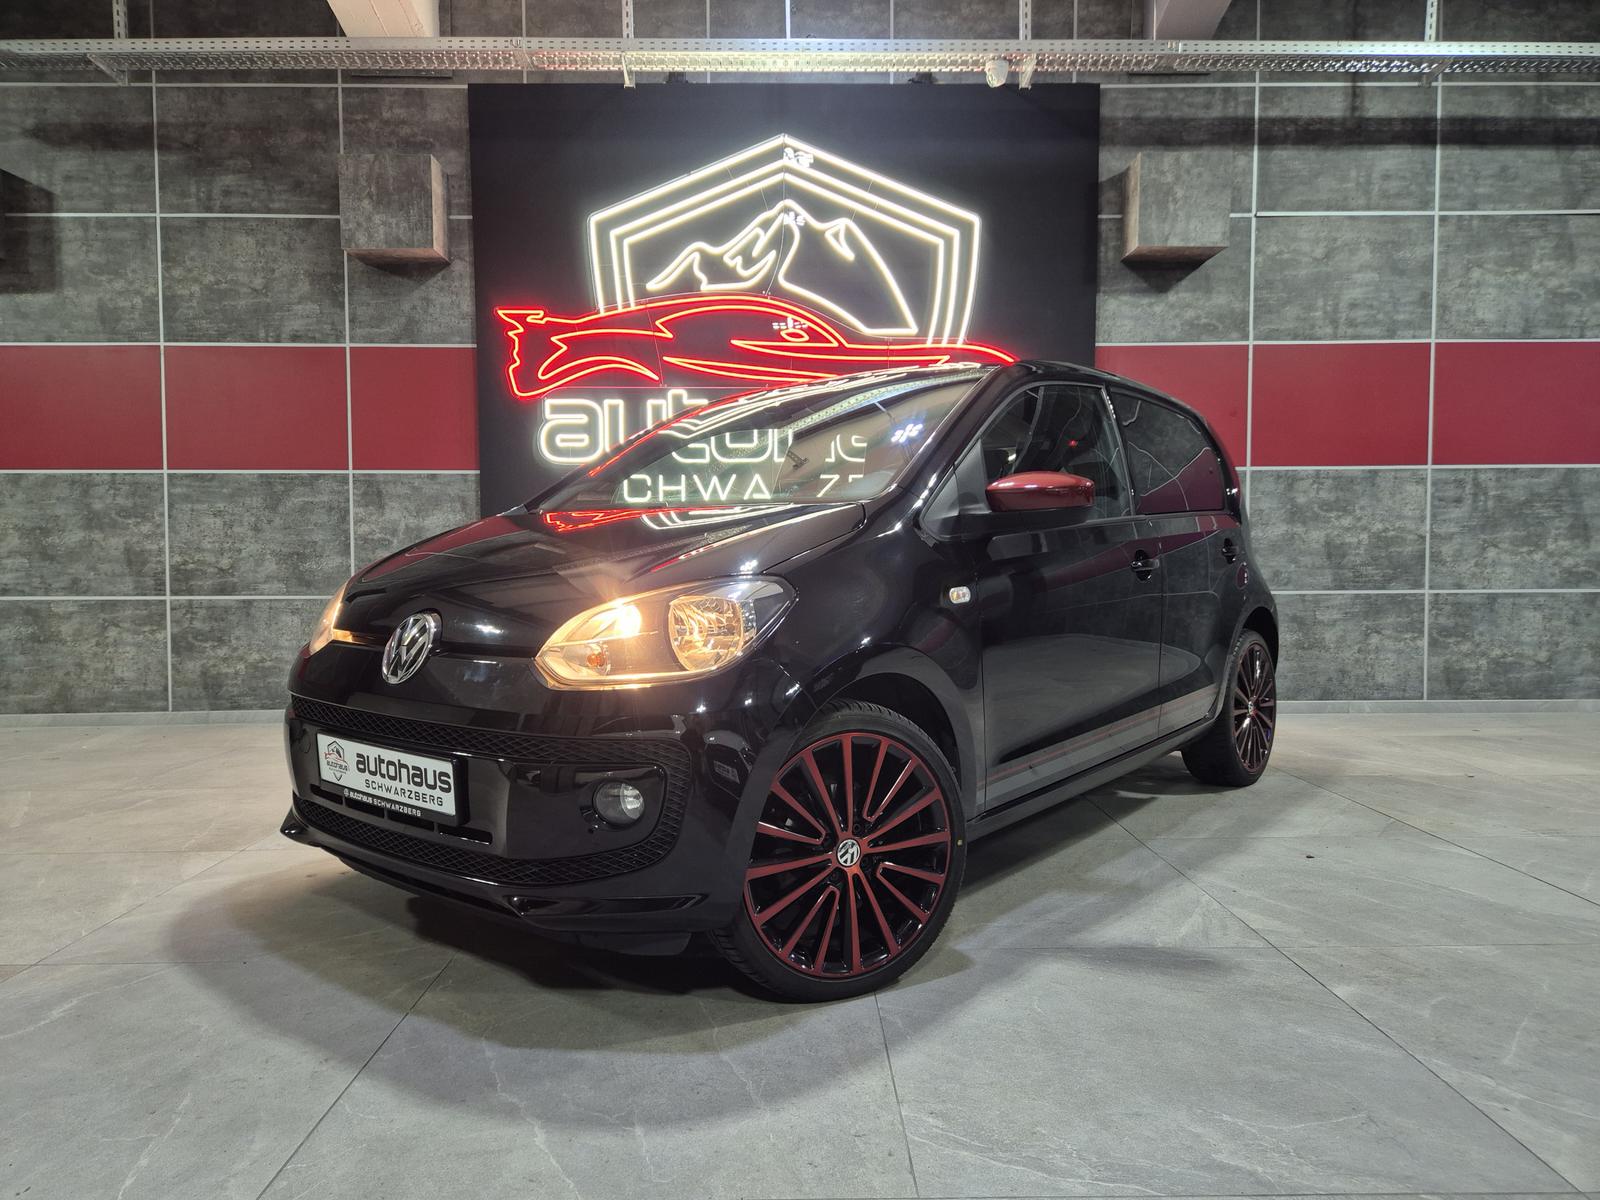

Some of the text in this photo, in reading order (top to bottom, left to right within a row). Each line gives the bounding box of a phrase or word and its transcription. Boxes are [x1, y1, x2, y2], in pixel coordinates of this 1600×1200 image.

[356, 752, 453, 794] autohaus
[349, 791, 421, 817] autohaus SCHWARZBERG
[364, 778, 444, 807] SCHWARZBERG
